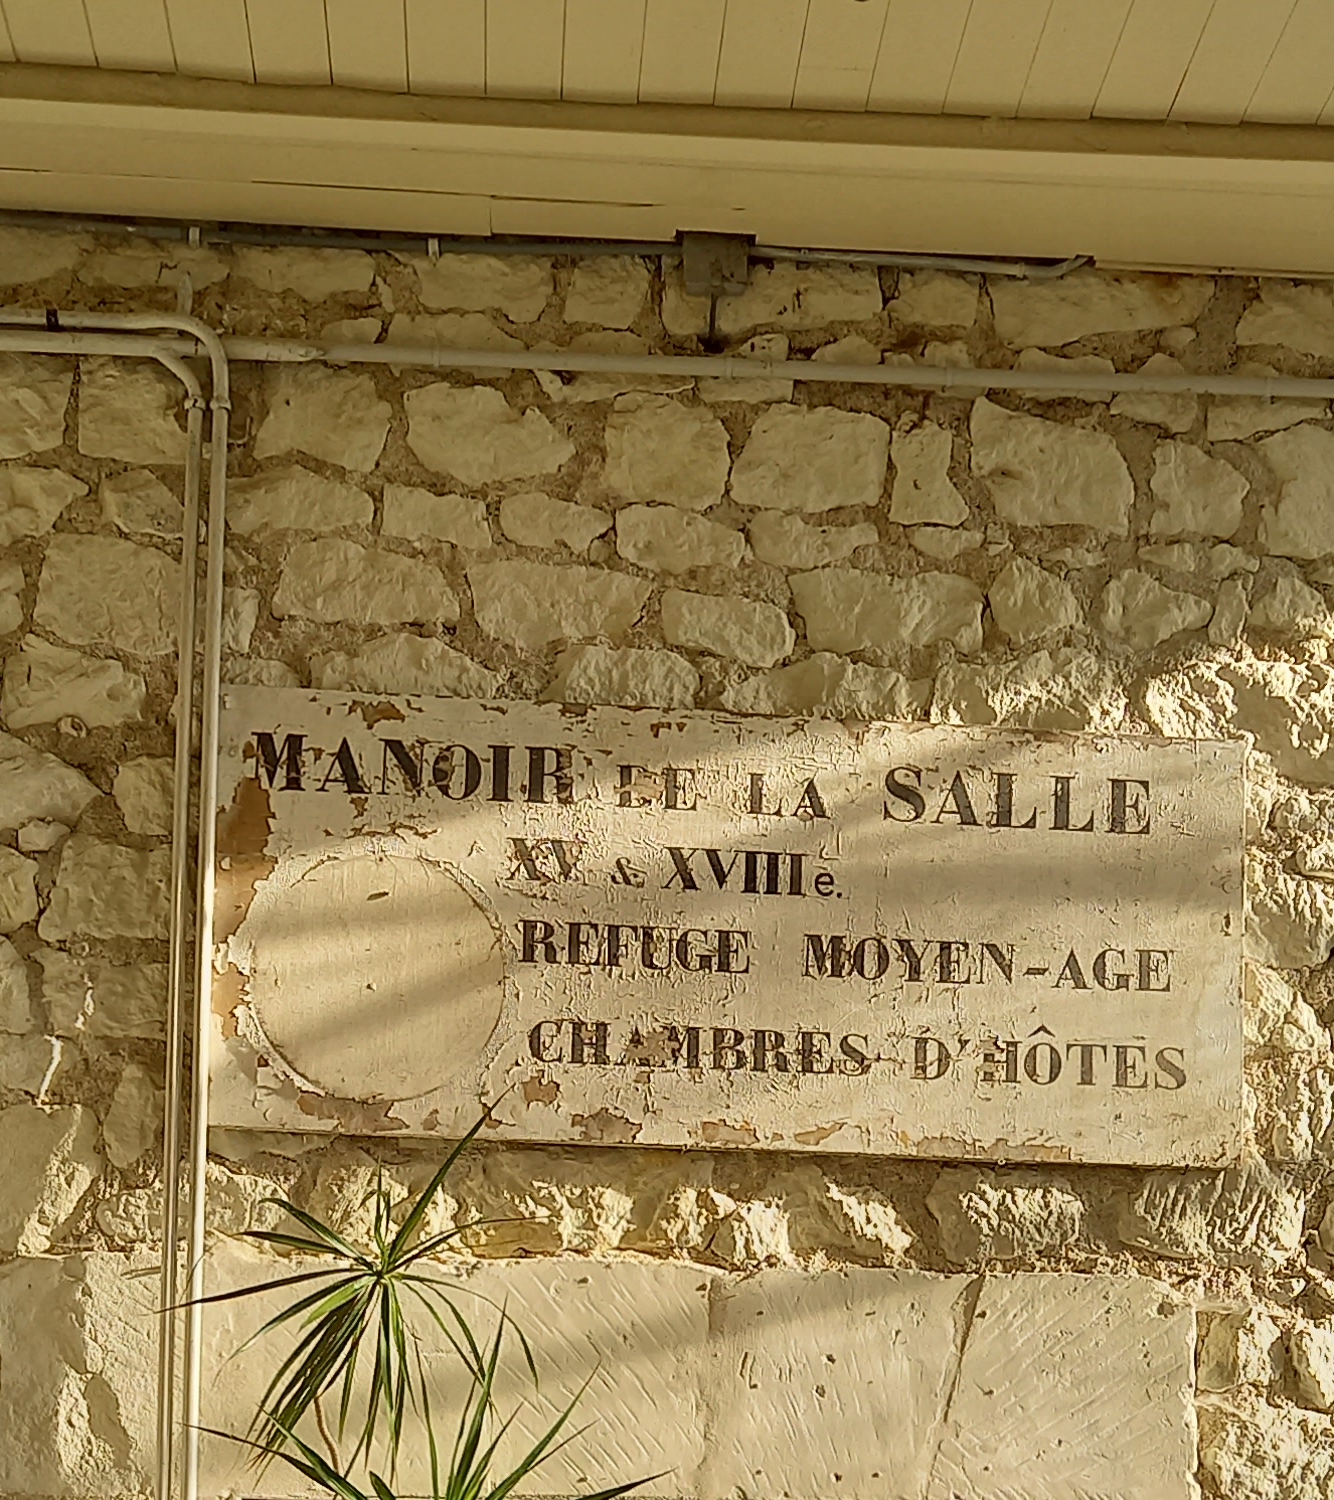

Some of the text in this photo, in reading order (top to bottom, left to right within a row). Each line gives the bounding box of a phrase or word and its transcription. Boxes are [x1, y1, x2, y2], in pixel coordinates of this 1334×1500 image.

[251, 731, 576, 804] MANOIR
[747, 772, 830, 819] LA
[883, 766, 1152, 835] SALLE
[505, 837, 588, 885] XV
[610, 857, 648, 888] &
[517, 919, 1172, 993] REFUGE MOYEN-AGE
[528, 1020, 869, 1077] CHAMBRES
